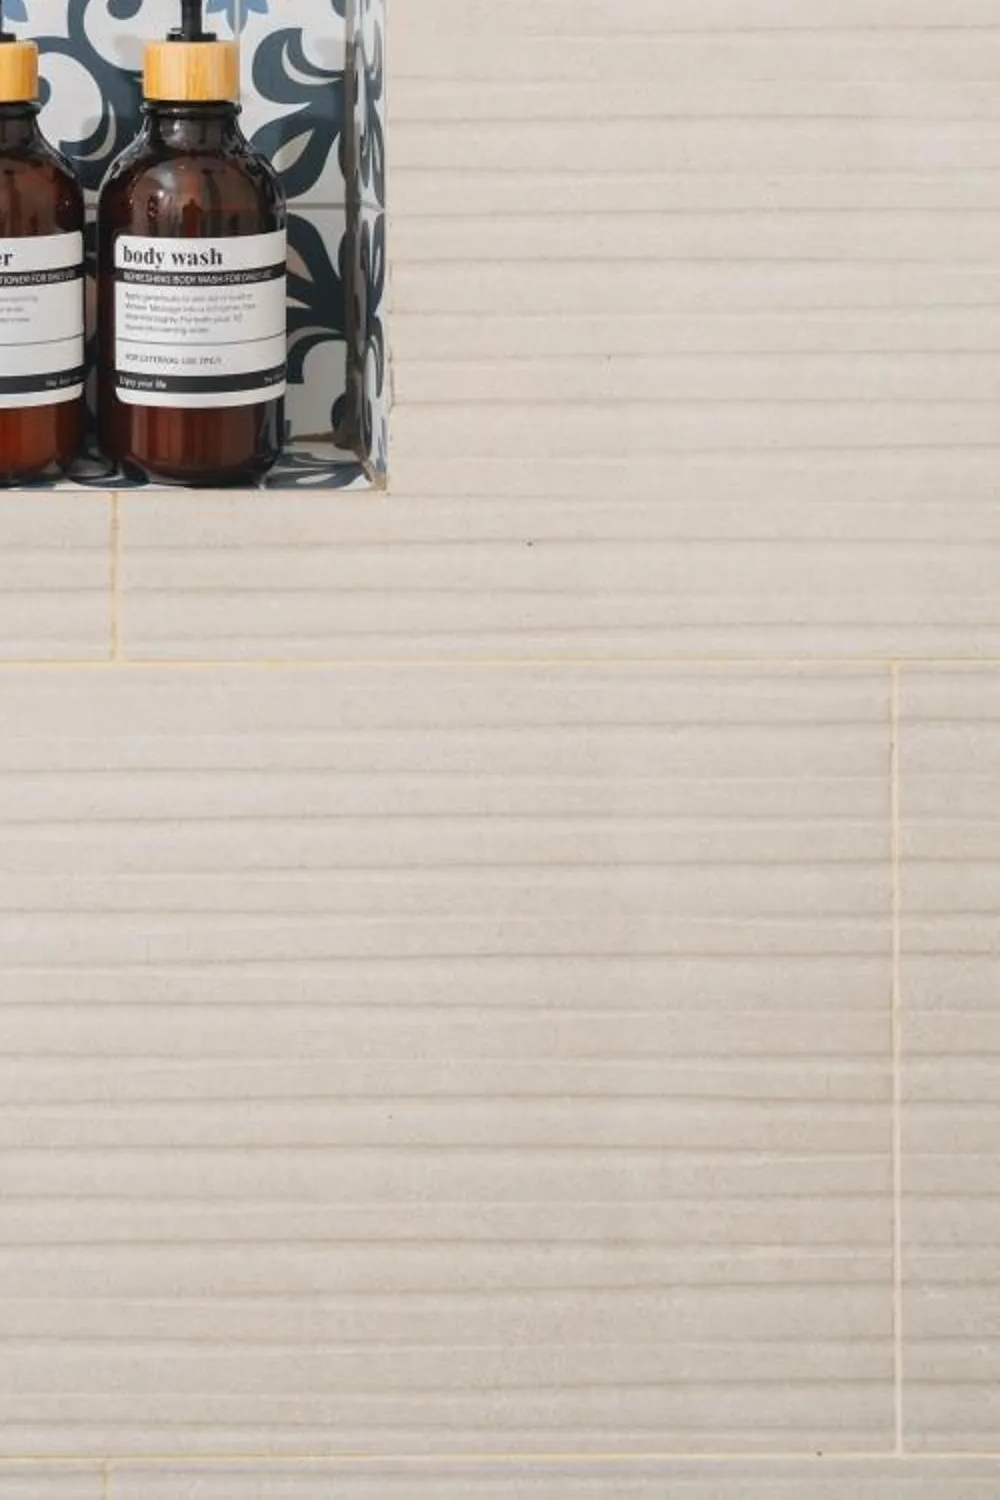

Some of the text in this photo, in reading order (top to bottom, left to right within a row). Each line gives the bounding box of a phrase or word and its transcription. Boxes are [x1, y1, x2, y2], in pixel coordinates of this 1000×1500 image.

[122, 244, 224, 271] body wash
[198, 274, 222, 285] WASH
